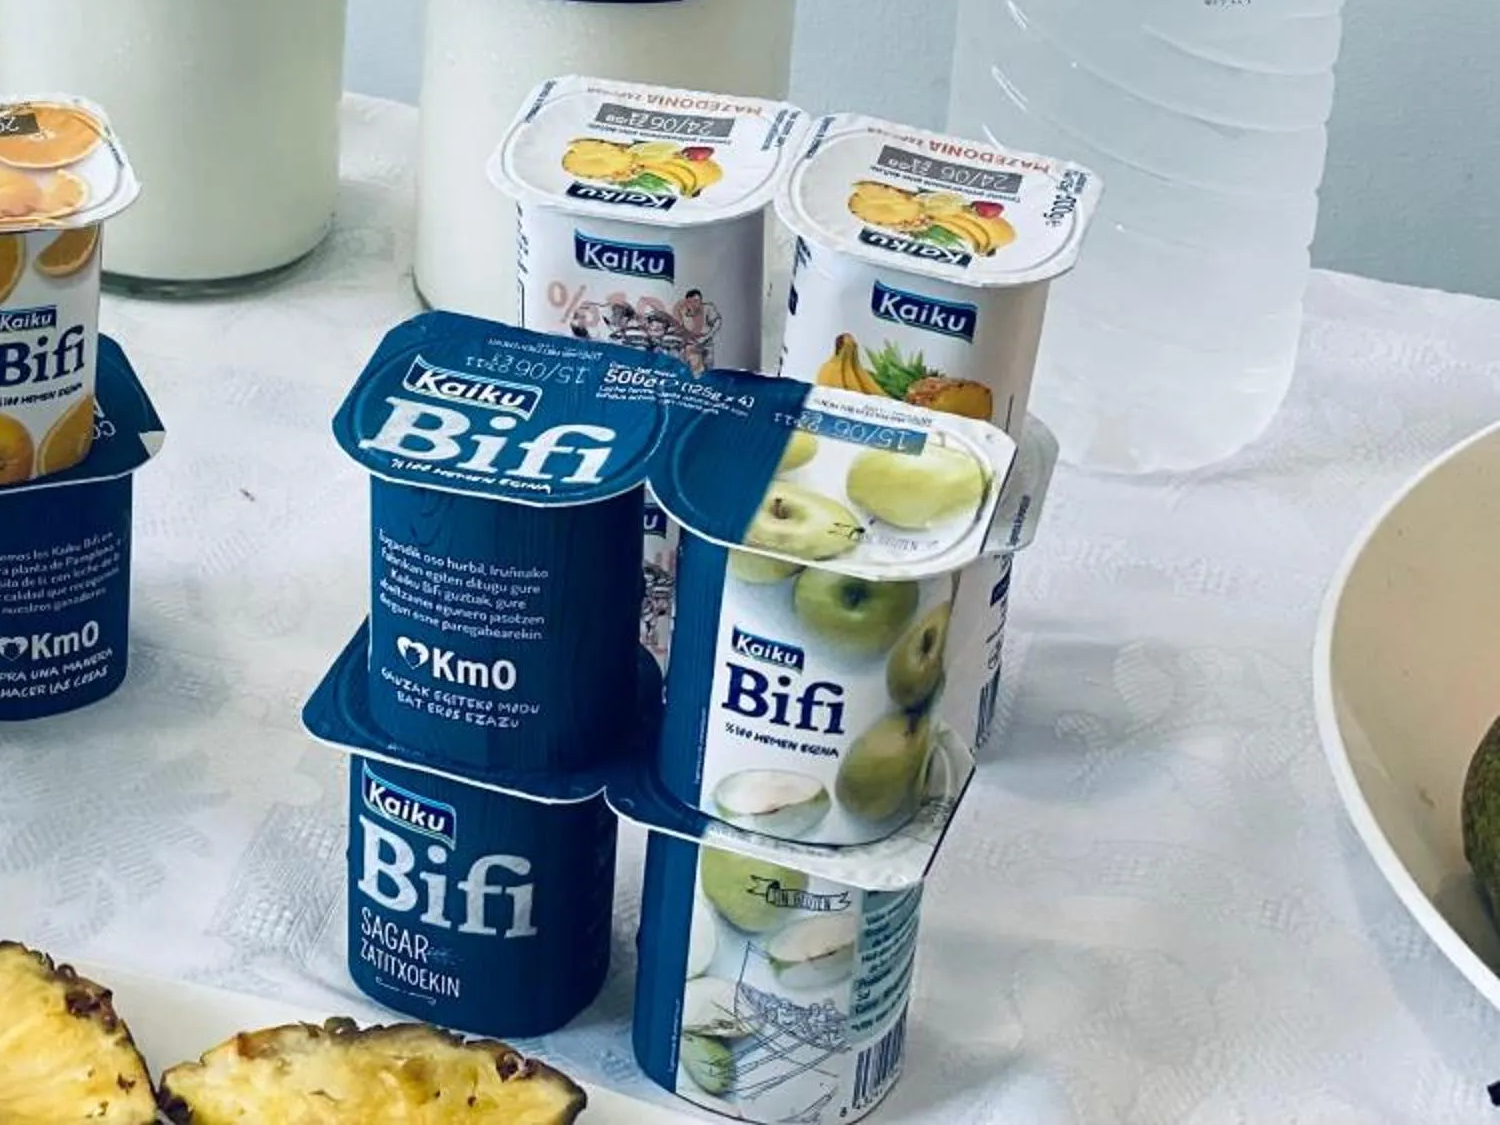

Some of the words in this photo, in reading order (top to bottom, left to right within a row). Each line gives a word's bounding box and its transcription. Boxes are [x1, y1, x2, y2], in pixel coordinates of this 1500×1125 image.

[649, 114, 715, 135] 24/06
[583, 241, 665, 275] Kaiku
[869, 232, 964, 266] Kaiku
[0, 311, 53, 331] Kaiku
[880, 291, 967, 332] Kaiku
[417, 370, 525, 407] Kaiku
[514, 358, 591, 385] 15/06
[358, 395, 617, 485] Bifi
[424, 554, 445, 567] oso
[495, 596, 528, 611] gure
[510, 583, 541, 597] gure
[736, 634, 800, 667] Kaiku
[721, 662, 846, 736] Bifi
[752, 730, 797, 752] HEMEN
[368, 780, 445, 833] Kaiku
[357, 813, 538, 940] Bifi
[360, 906, 430, 964] SAGAR
[360, 936, 461, 999] ZATITXOEKIN
